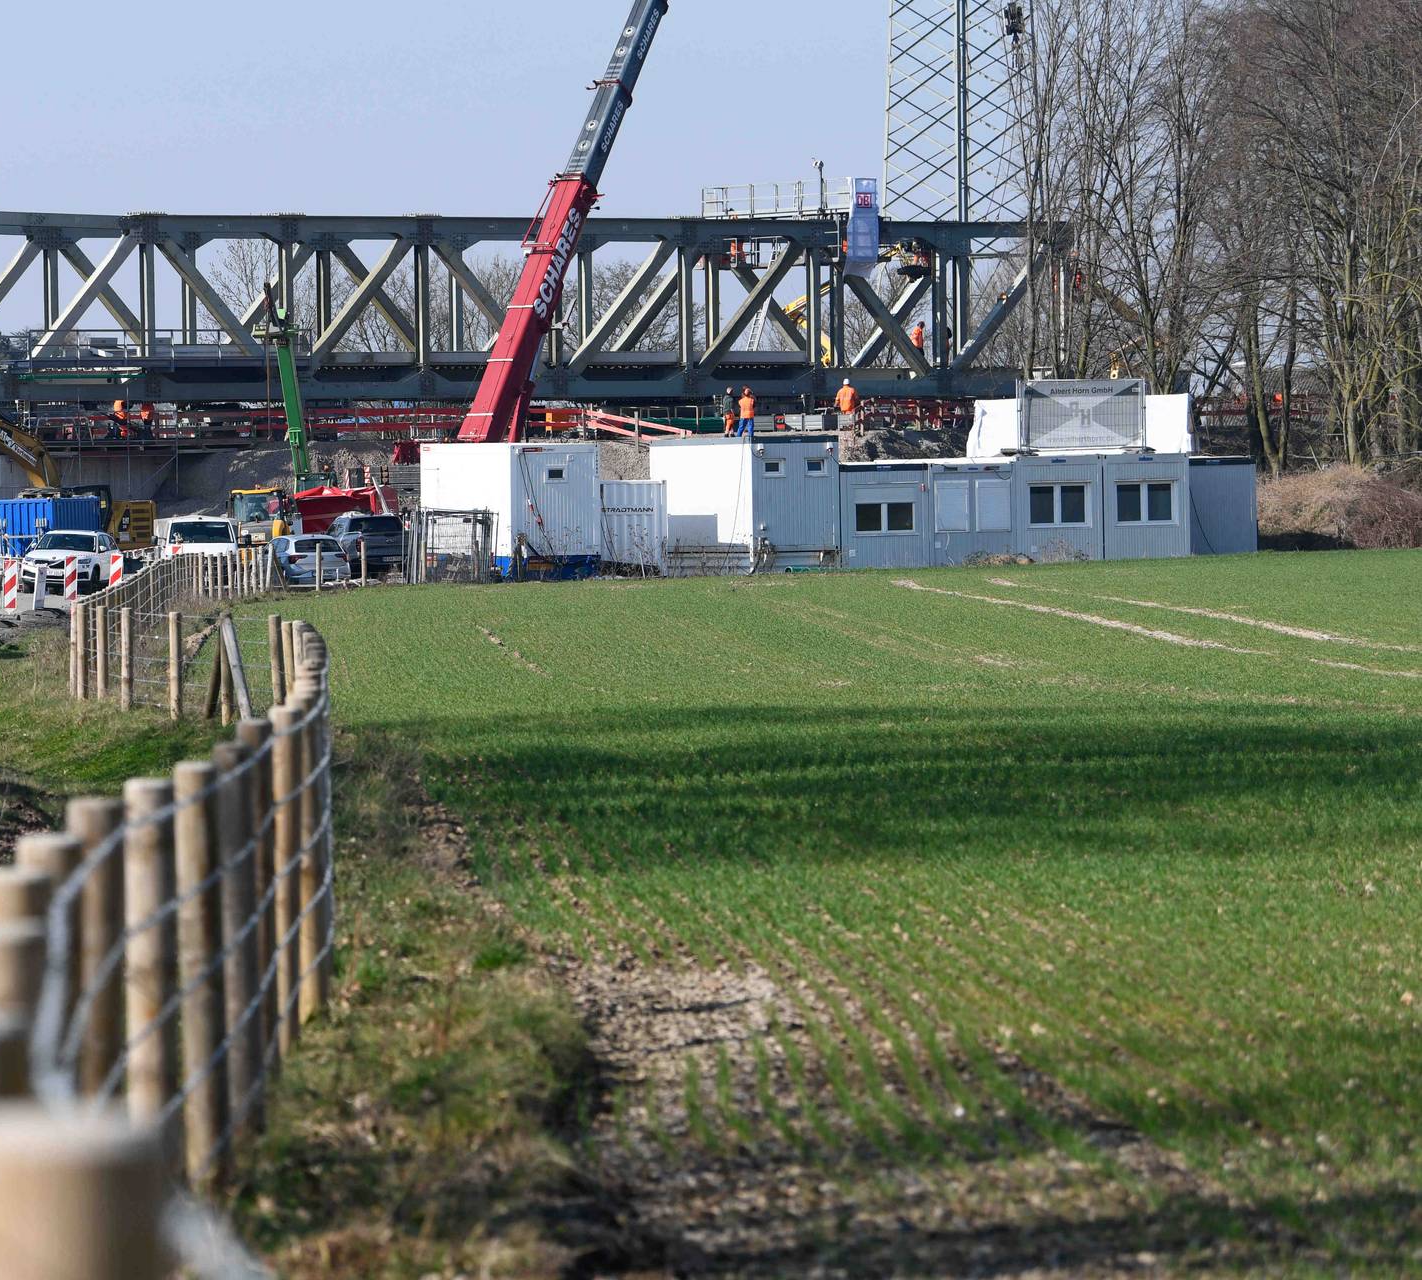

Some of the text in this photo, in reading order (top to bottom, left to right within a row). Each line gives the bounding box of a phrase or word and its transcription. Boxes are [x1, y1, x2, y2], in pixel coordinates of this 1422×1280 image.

[637, 8, 660, 60] SCHARES
[601, 100, 624, 153] SCHARES
[857, 194, 871, 206] DB
[533, 207, 581, 320] SCHARES
[1072, 387, 1090, 395] Horn
[1091, 386, 1114, 394] GmbH
